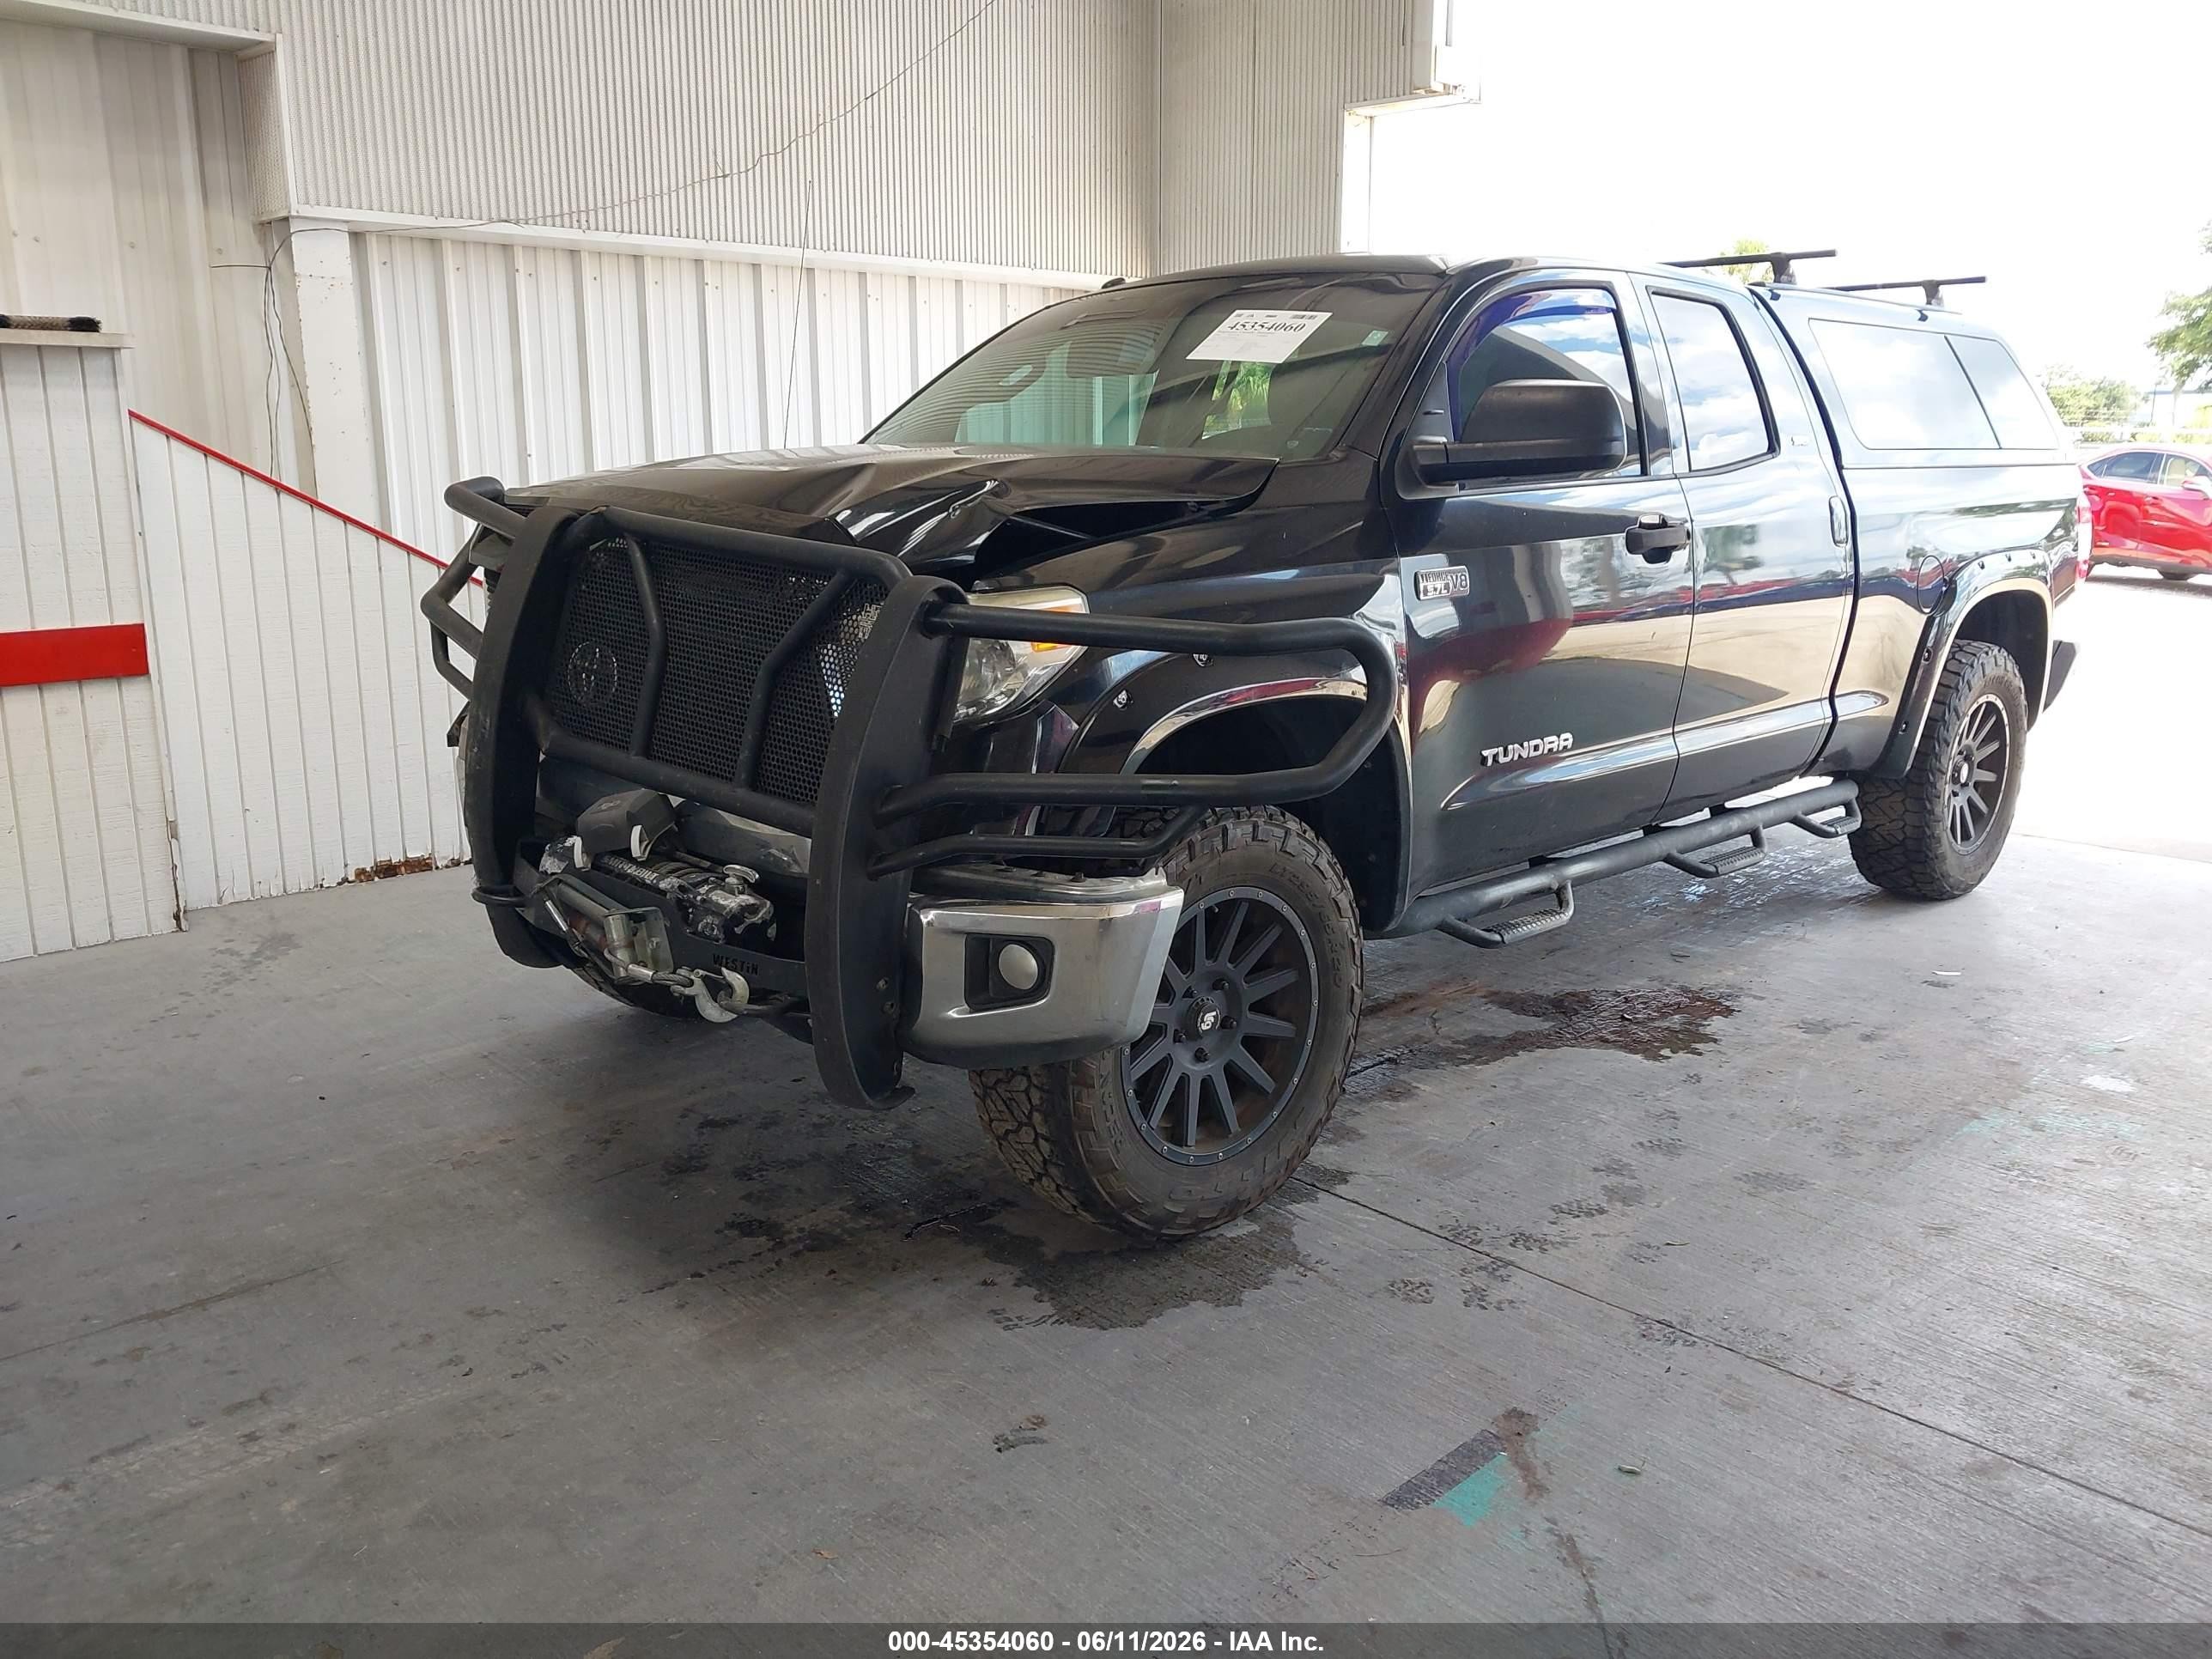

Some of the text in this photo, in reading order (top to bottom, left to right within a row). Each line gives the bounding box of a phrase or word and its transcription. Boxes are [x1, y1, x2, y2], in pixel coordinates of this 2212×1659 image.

[1227, 320, 1306, 333] 45354060
[1449, 573, 1468, 591] V8
[1480, 732, 1574, 767] TUNDRA
